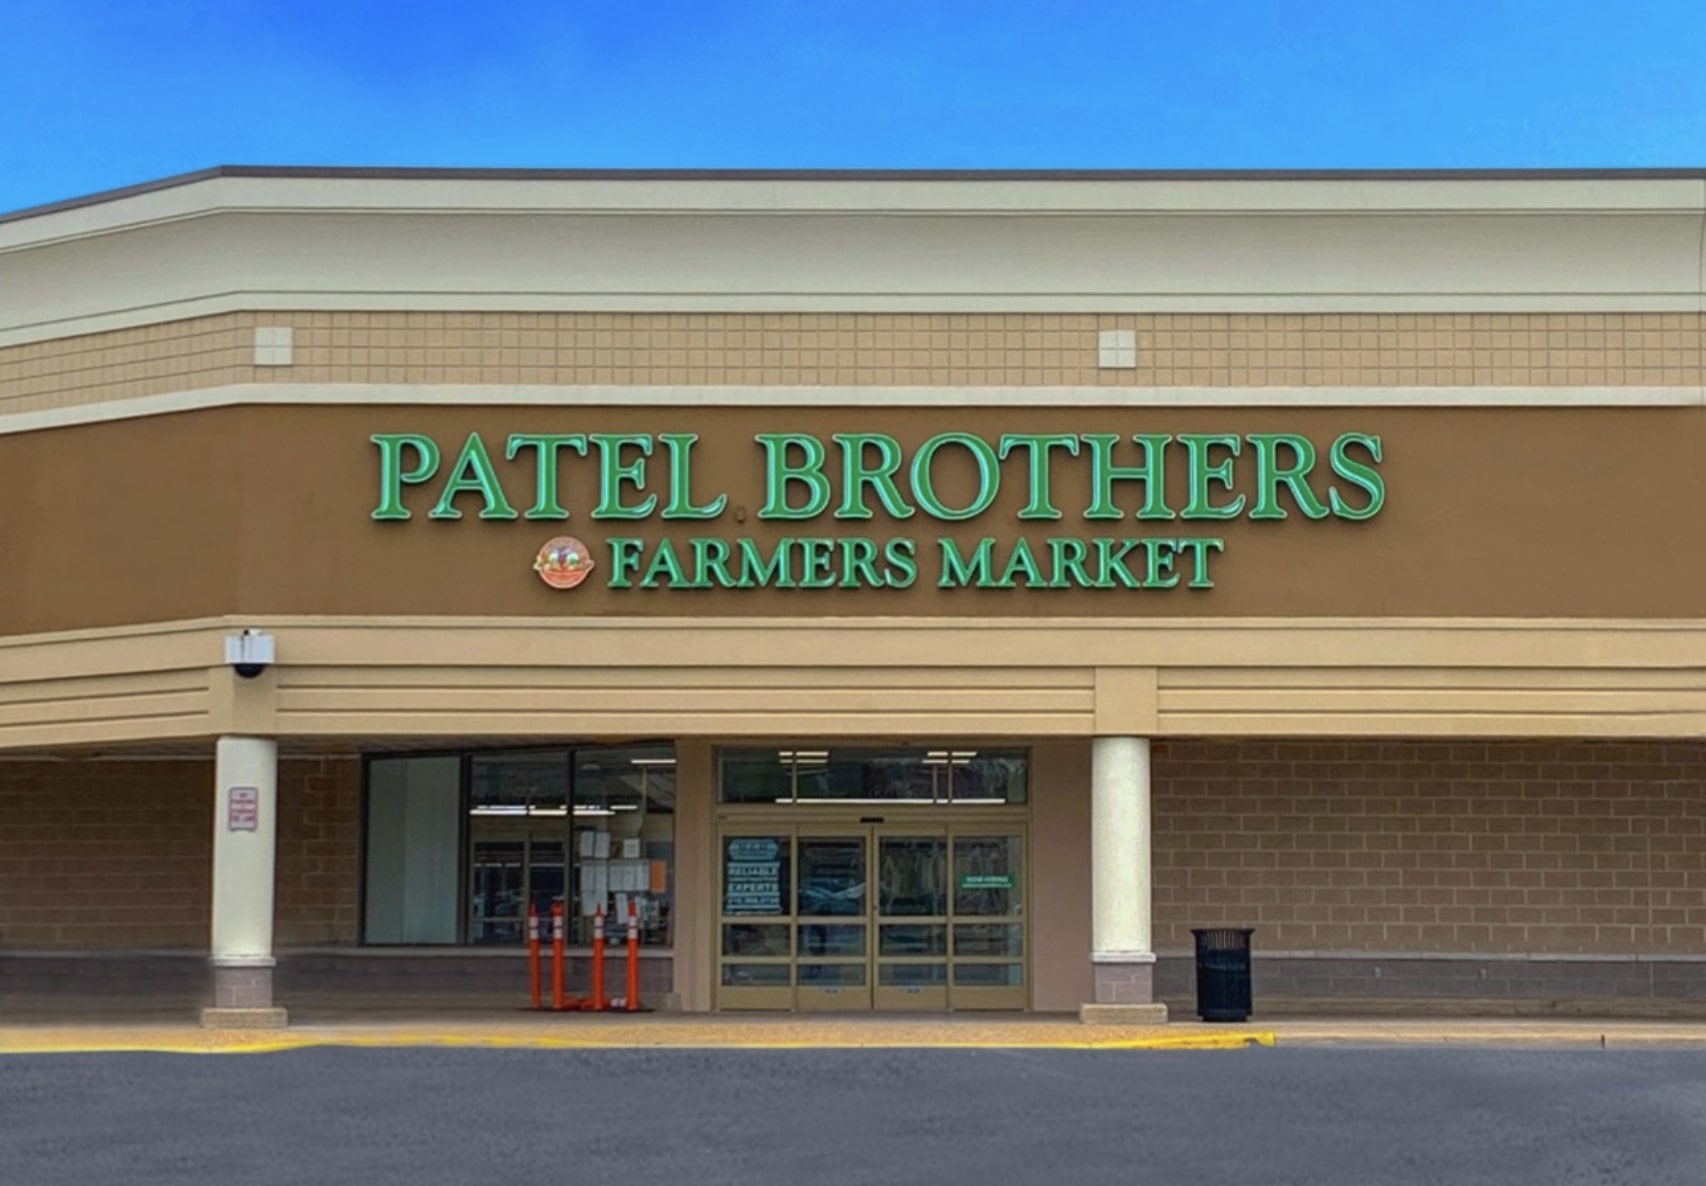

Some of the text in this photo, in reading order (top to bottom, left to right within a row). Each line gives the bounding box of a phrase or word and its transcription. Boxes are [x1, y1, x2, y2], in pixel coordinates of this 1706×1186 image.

[370, 432, 1387, 521] PATEL BROTHERS
[606, 536, 1225, 589] FARMERS MARKET
[728, 882, 779, 893] EXPERTS
